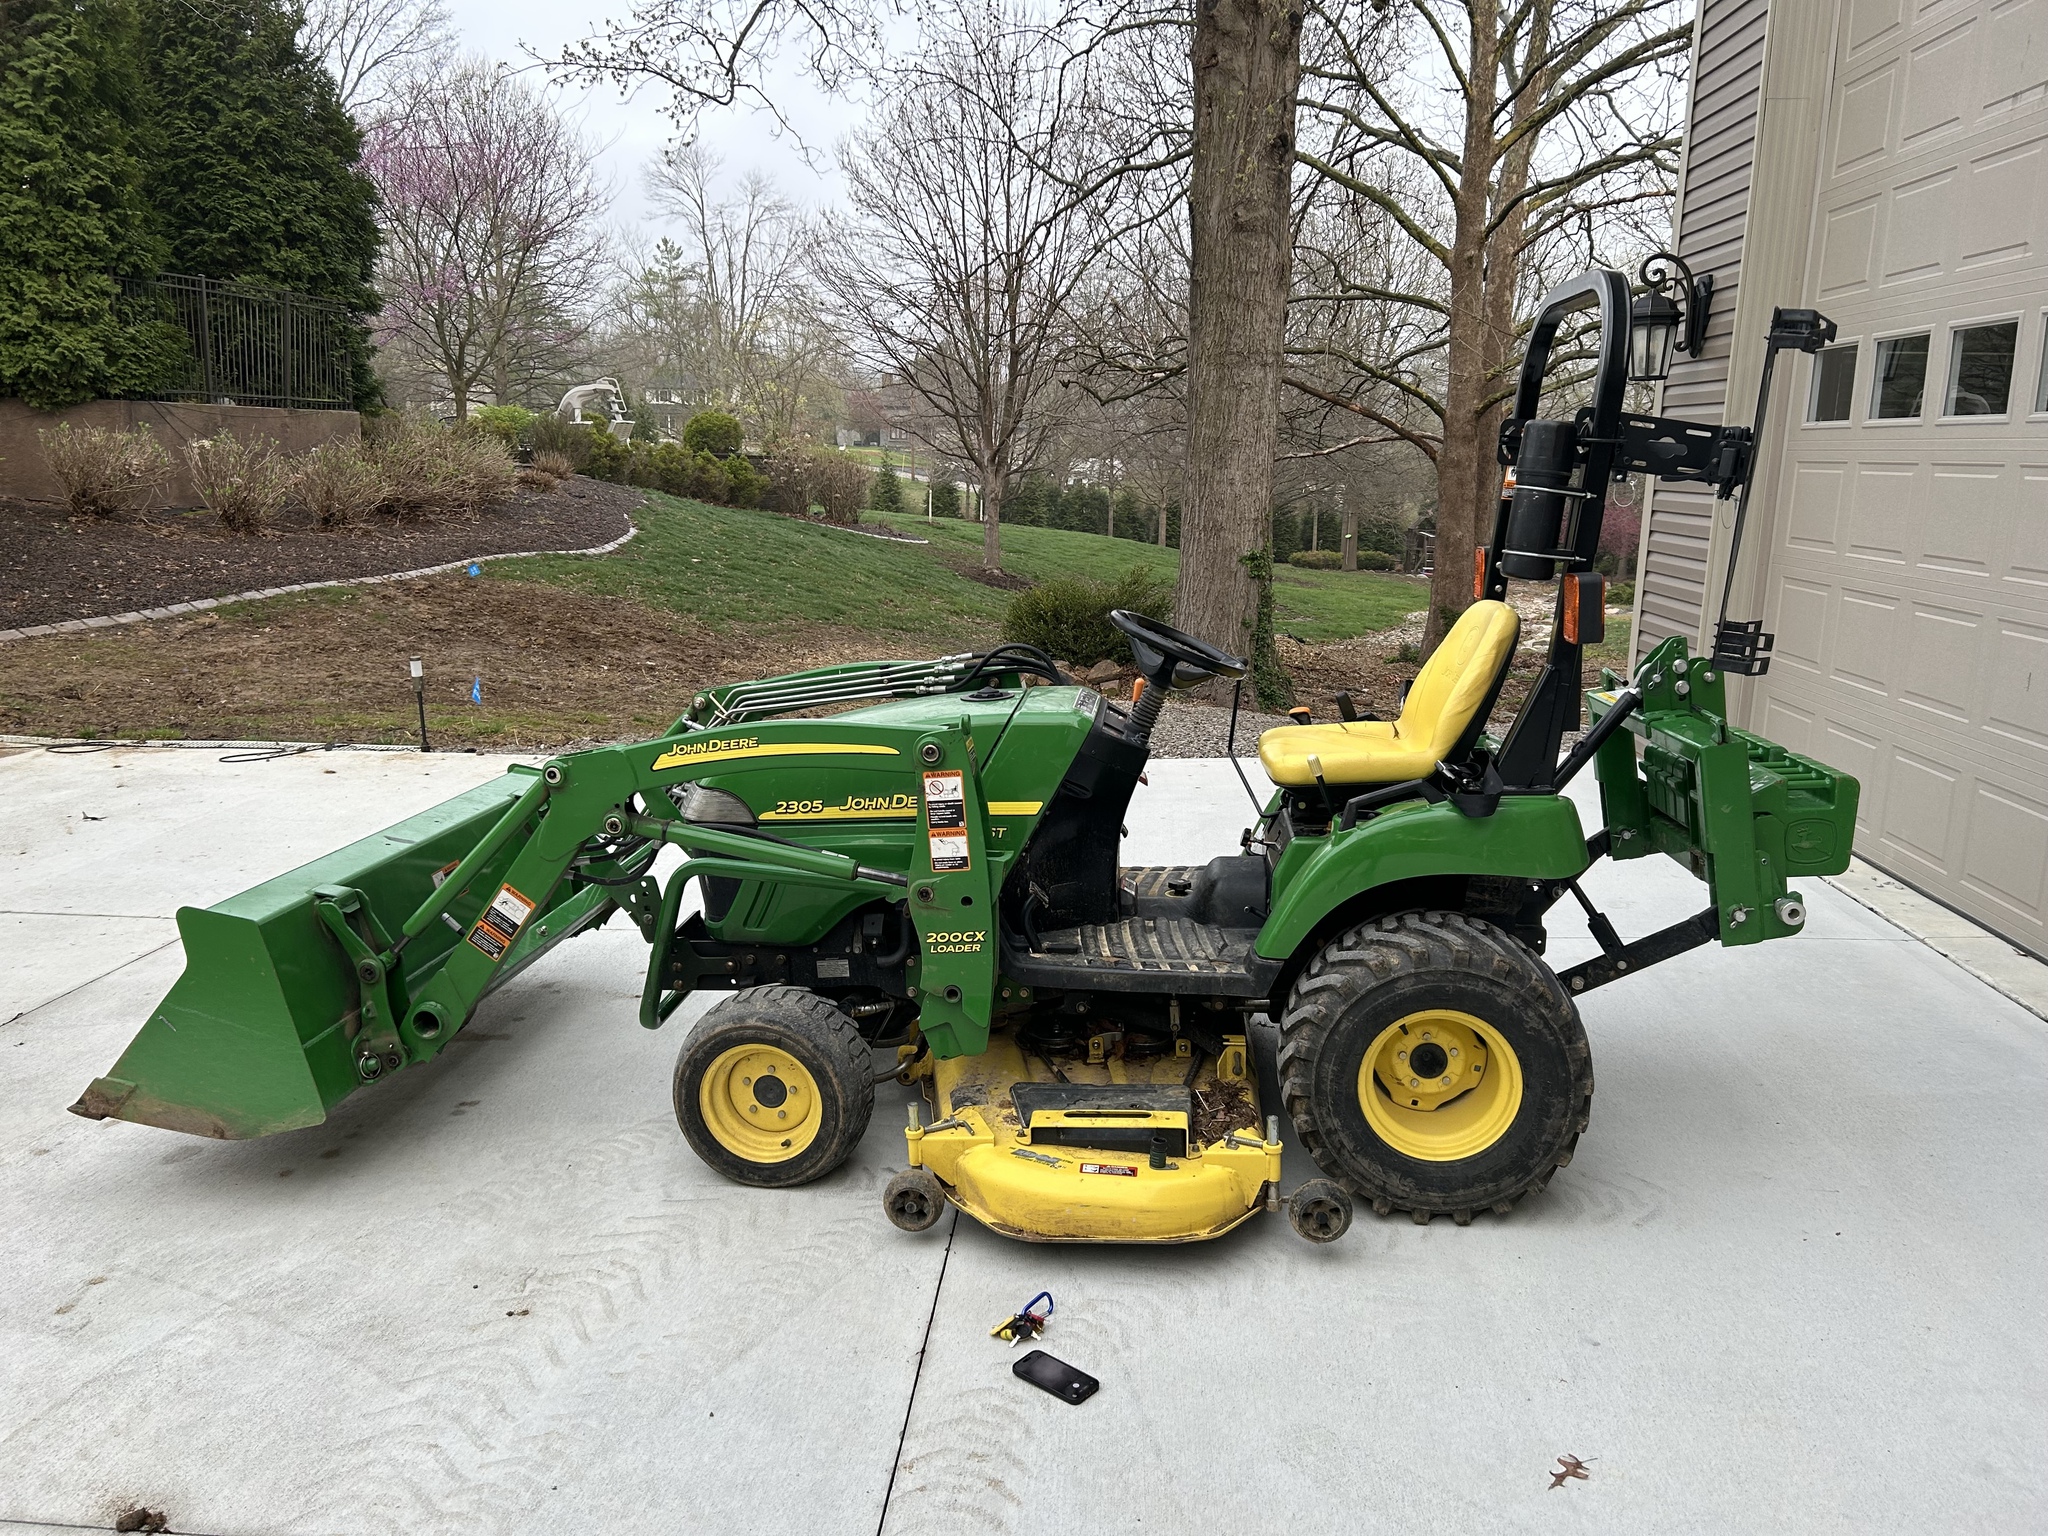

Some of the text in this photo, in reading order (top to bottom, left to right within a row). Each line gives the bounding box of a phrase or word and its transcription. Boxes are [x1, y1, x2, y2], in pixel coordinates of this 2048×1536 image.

[667, 737, 759, 756] JOHN DEERE
[930, 770, 961, 778] WARNING
[775, 799, 824, 815] 2305
[839, 795, 890, 811] JOHN
[936, 830, 966, 838] WARNING
[926, 930, 987, 943] 200CX
[930, 944, 982, 954] LOADER
